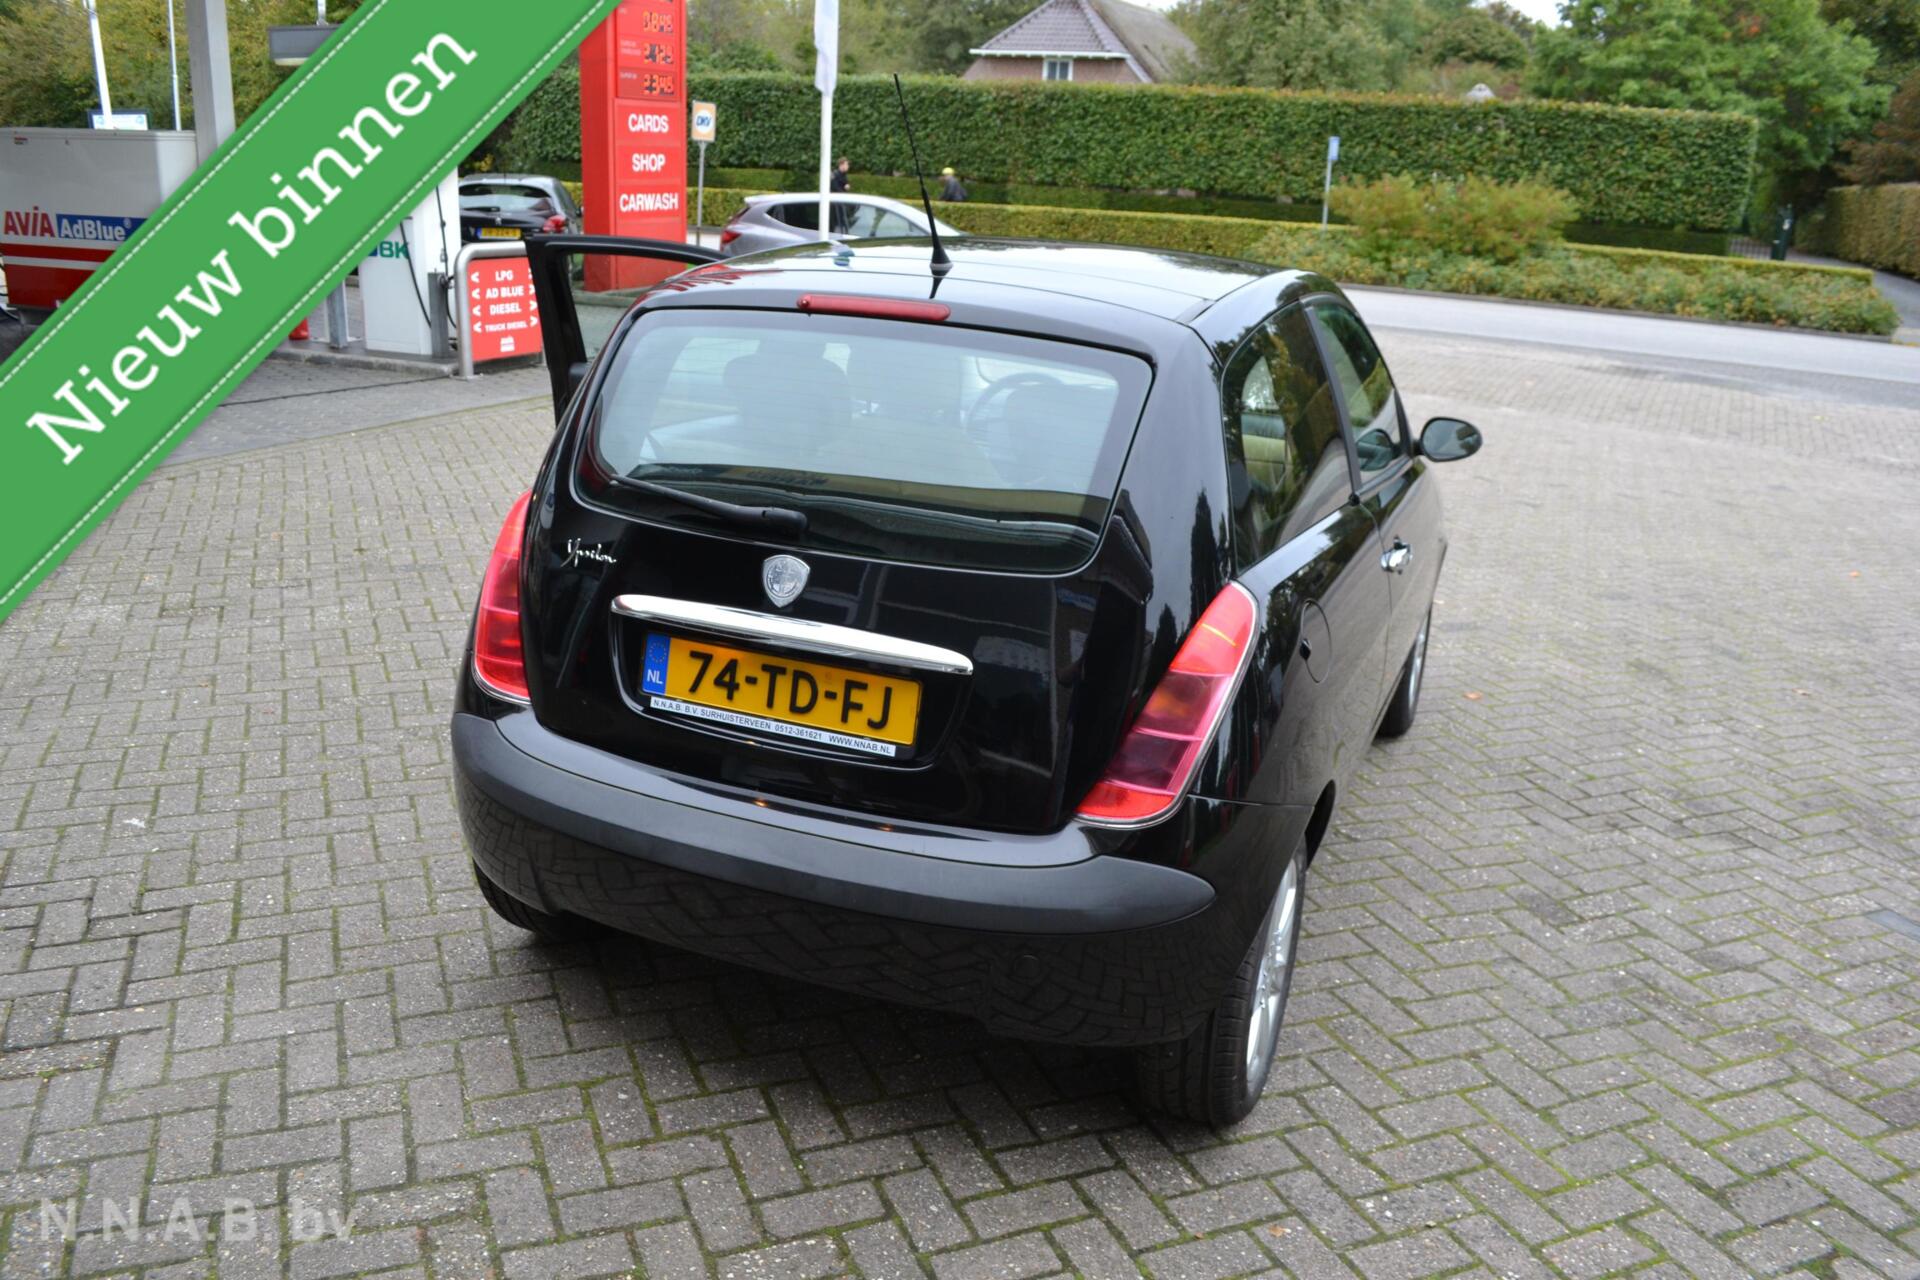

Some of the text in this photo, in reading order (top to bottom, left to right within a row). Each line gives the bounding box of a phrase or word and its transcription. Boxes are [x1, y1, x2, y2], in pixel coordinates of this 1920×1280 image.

[628, 113, 669, 133] CARDS
[632, 153, 666, 172] SHOP
[620, 192, 679, 212] CARWASH
[495, 269, 514, 282] LPG
[485, 285, 525, 299] AD BLUE
[489, 302, 522, 316] DIESEL
[647, 650, 894, 731] NL 74-TD-FJ
[684, 705, 700, 716] B.V.
[700, 708, 771, 730] SURHUISTERVEEN
[774, 723, 823, 741] 0512-361621
[828, 735, 892, 755] WWW.NNAB.NL
